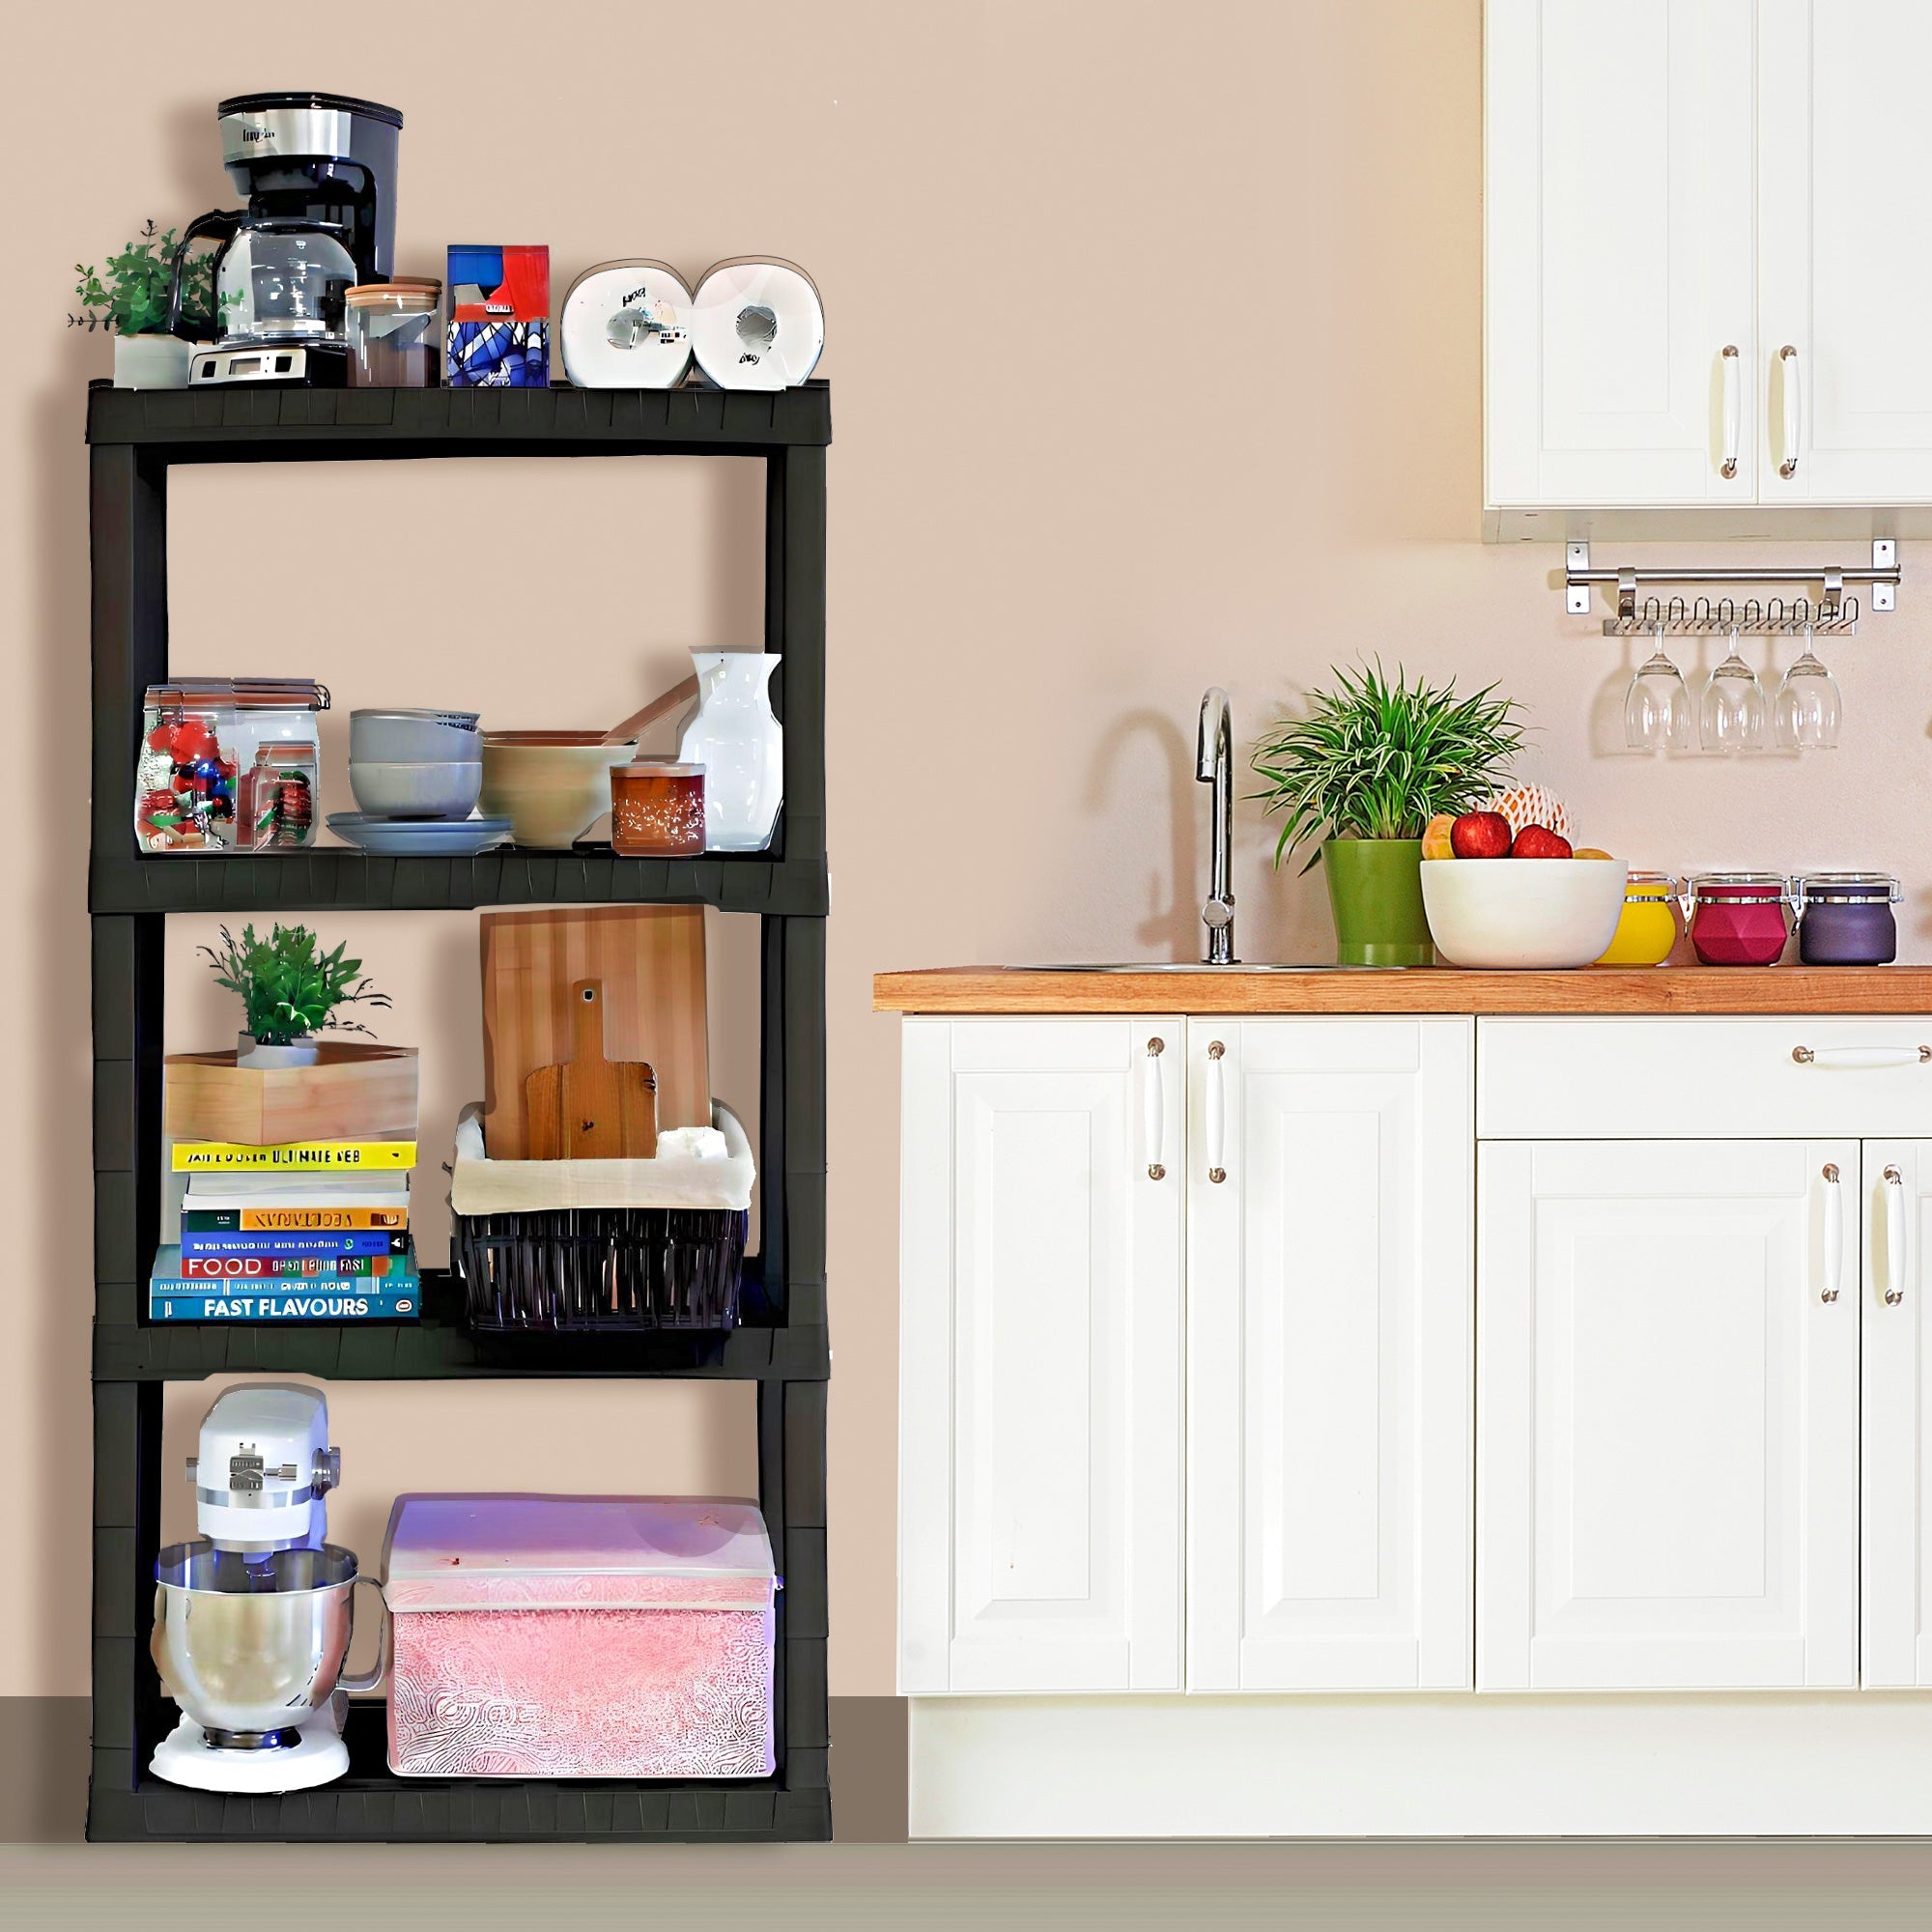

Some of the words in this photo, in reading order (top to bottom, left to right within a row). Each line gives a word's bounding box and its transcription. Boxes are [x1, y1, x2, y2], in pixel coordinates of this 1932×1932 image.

[188, 1258, 262, 1275] FOOD
[204, 1298, 253, 1317] FAST
[259, 1297, 369, 1317] FLAVOURS
